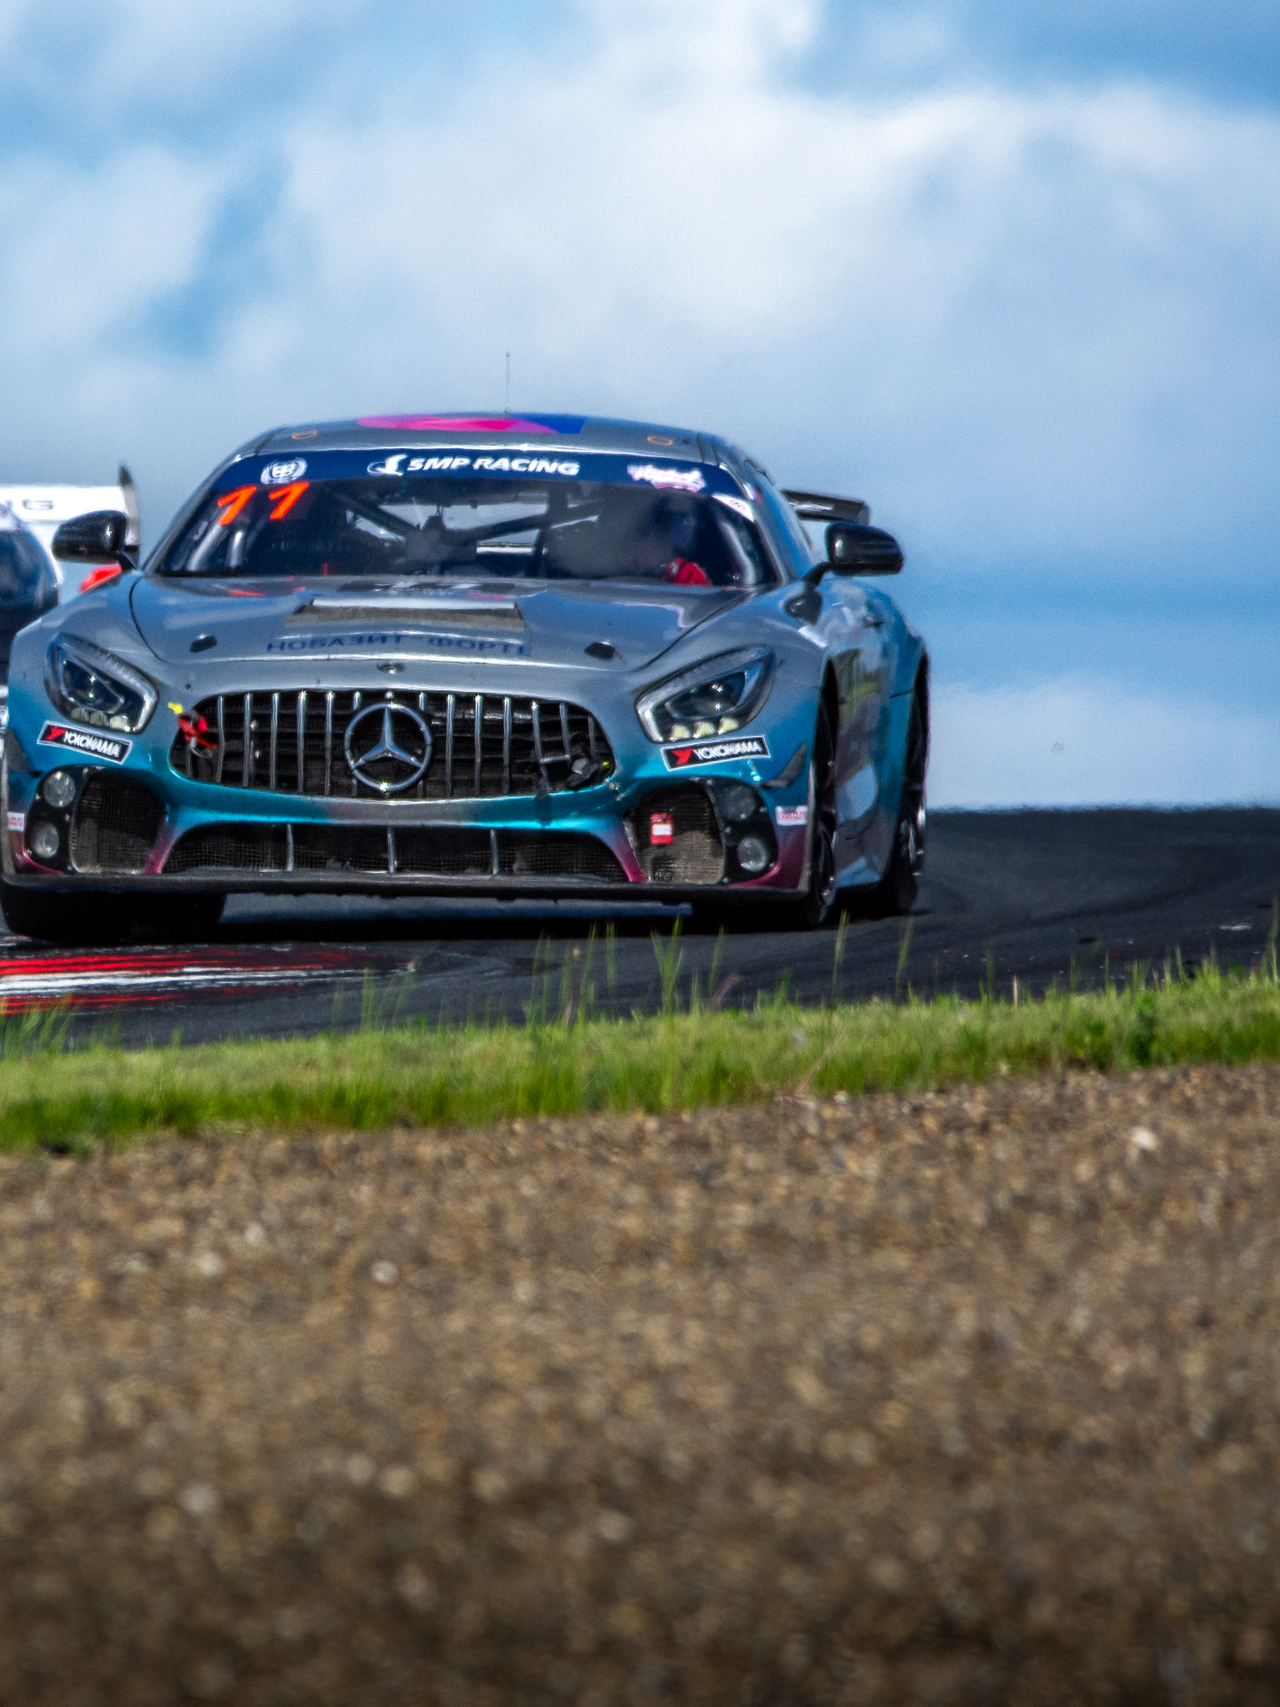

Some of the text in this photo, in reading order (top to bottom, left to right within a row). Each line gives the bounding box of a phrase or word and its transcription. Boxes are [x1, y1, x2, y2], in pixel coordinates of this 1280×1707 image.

[406, 456, 581, 476] SMP RACING
[217, 480, 311, 526] 11
[63, 732, 121, 758] YOKOHAMA
[693, 741, 762, 759] YOKOHAMA
